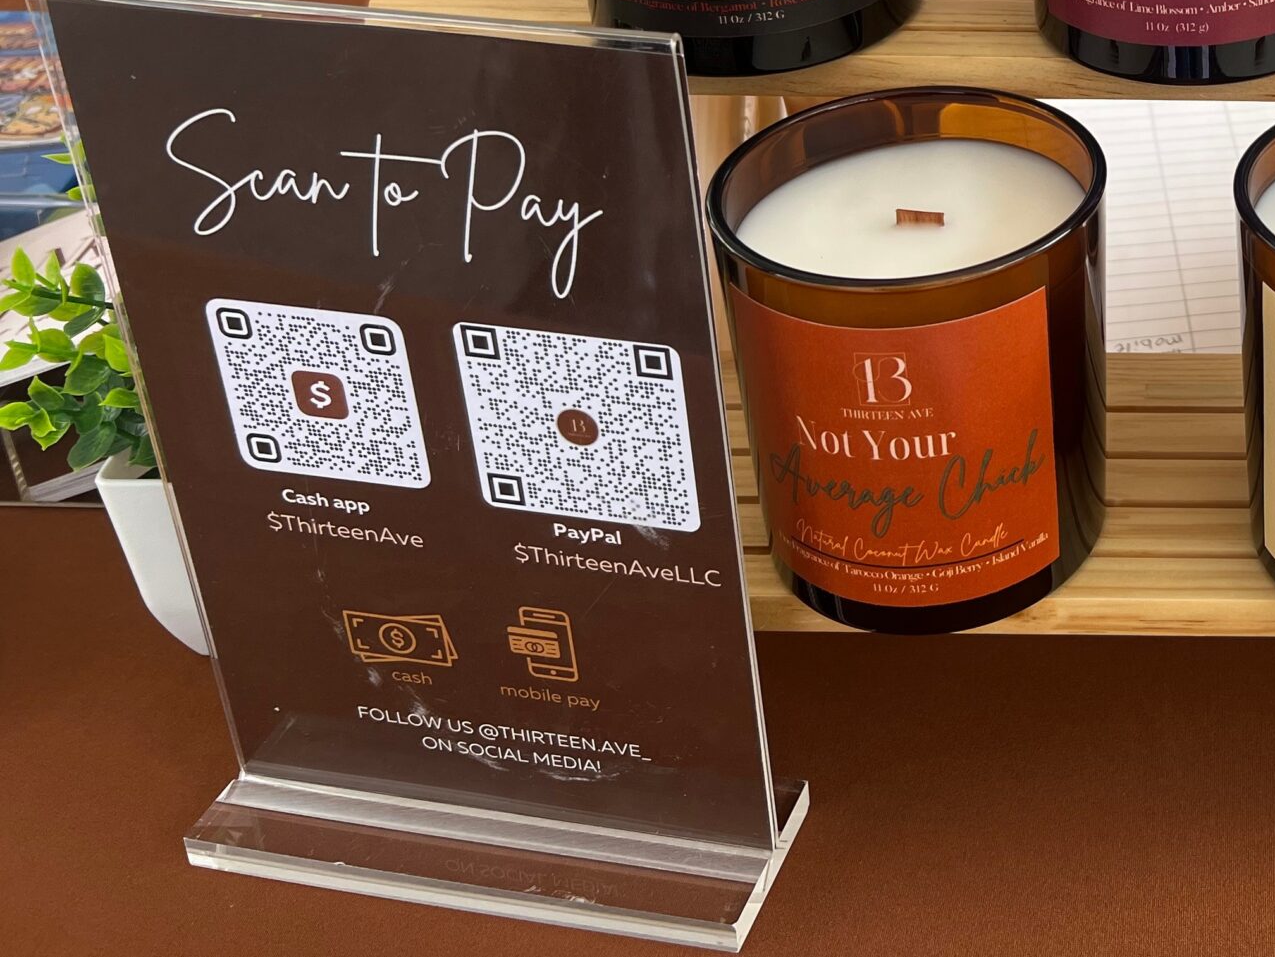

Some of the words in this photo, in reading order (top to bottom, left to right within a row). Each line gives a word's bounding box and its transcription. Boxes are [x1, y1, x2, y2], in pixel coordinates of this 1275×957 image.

[701, 2, 757, 15] Bergamot
[730, 15, 745, 24] Oz
[755, 12, 773, 21] 312
[1129, 1, 1154, 12] Lime
[1155, 3, 1197, 15] Blossom
[1206, 1, 1241, 14] Amber
[1156, 22, 1169, 32] Oz
[165, 108, 350, 236] Scan
[340, 133, 443, 256] to
[440, 129, 603, 299] Pay
[864, 356, 912, 403] 13
[841, 407, 904, 420] THIRTEEN
[908, 408, 934, 419] AVE
[796, 415, 855, 458] Not
[861, 429, 956, 460] Your
[770, 444, 925, 538] Average
[938, 429, 1045, 520] Chick
[281, 488, 329, 511] Cash
[333, 497, 370, 516] app
[266, 512, 424, 549] $ThirteenAve
[553, 523, 622, 546] PayPal
[796, 519, 848, 557] Natural
[853, 538, 920, 566] Coconut
[915, 540, 952, 563] Wax
[961, 522, 1008, 557] Candle
[513, 544, 722, 588] $ThirteenAveLLC
[884, 570, 923, 582] Orange
[953, 560, 981, 575] Berry
[909, 584, 927, 593] 312
[392, 670, 432, 685] cash
[500, 684, 562, 704] mobile
[567, 694, 600, 711] pay
[358, 706, 442, 730] FOLLOW
[446, 718, 474, 734] US
[478, 723, 652, 762] @THIRTEEN.AVE_
[422, 736, 452, 752] ON
[456, 740, 529, 762] SOCIAL
[534, 752, 601, 772] MEDIA!
